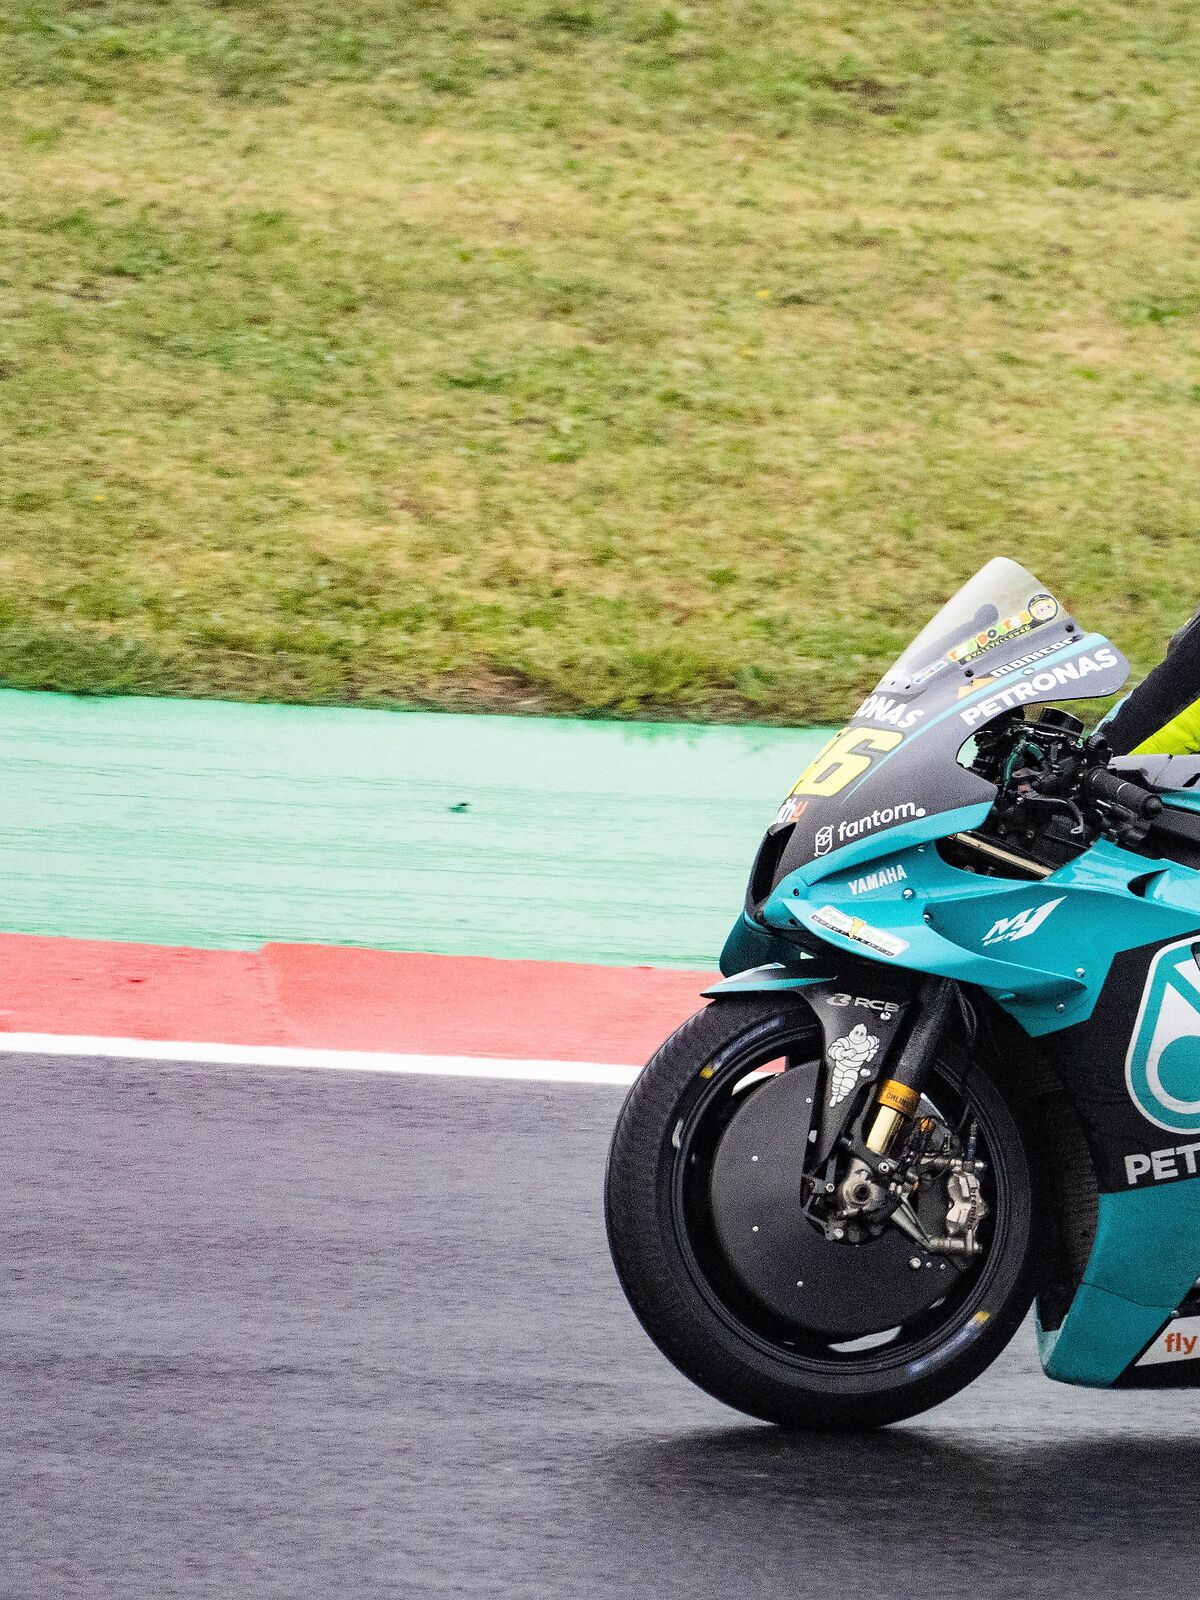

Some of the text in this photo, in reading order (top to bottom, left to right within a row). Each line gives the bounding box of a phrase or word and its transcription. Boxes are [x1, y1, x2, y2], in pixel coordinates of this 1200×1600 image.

[959, 648, 1119, 726] PETRONAS
[853, 695, 925, 728] ONAS
[787, 727, 904, 798] 6
[848, 864, 908, 895] YAMAHA
[854, 996, 900, 1013] RCB
